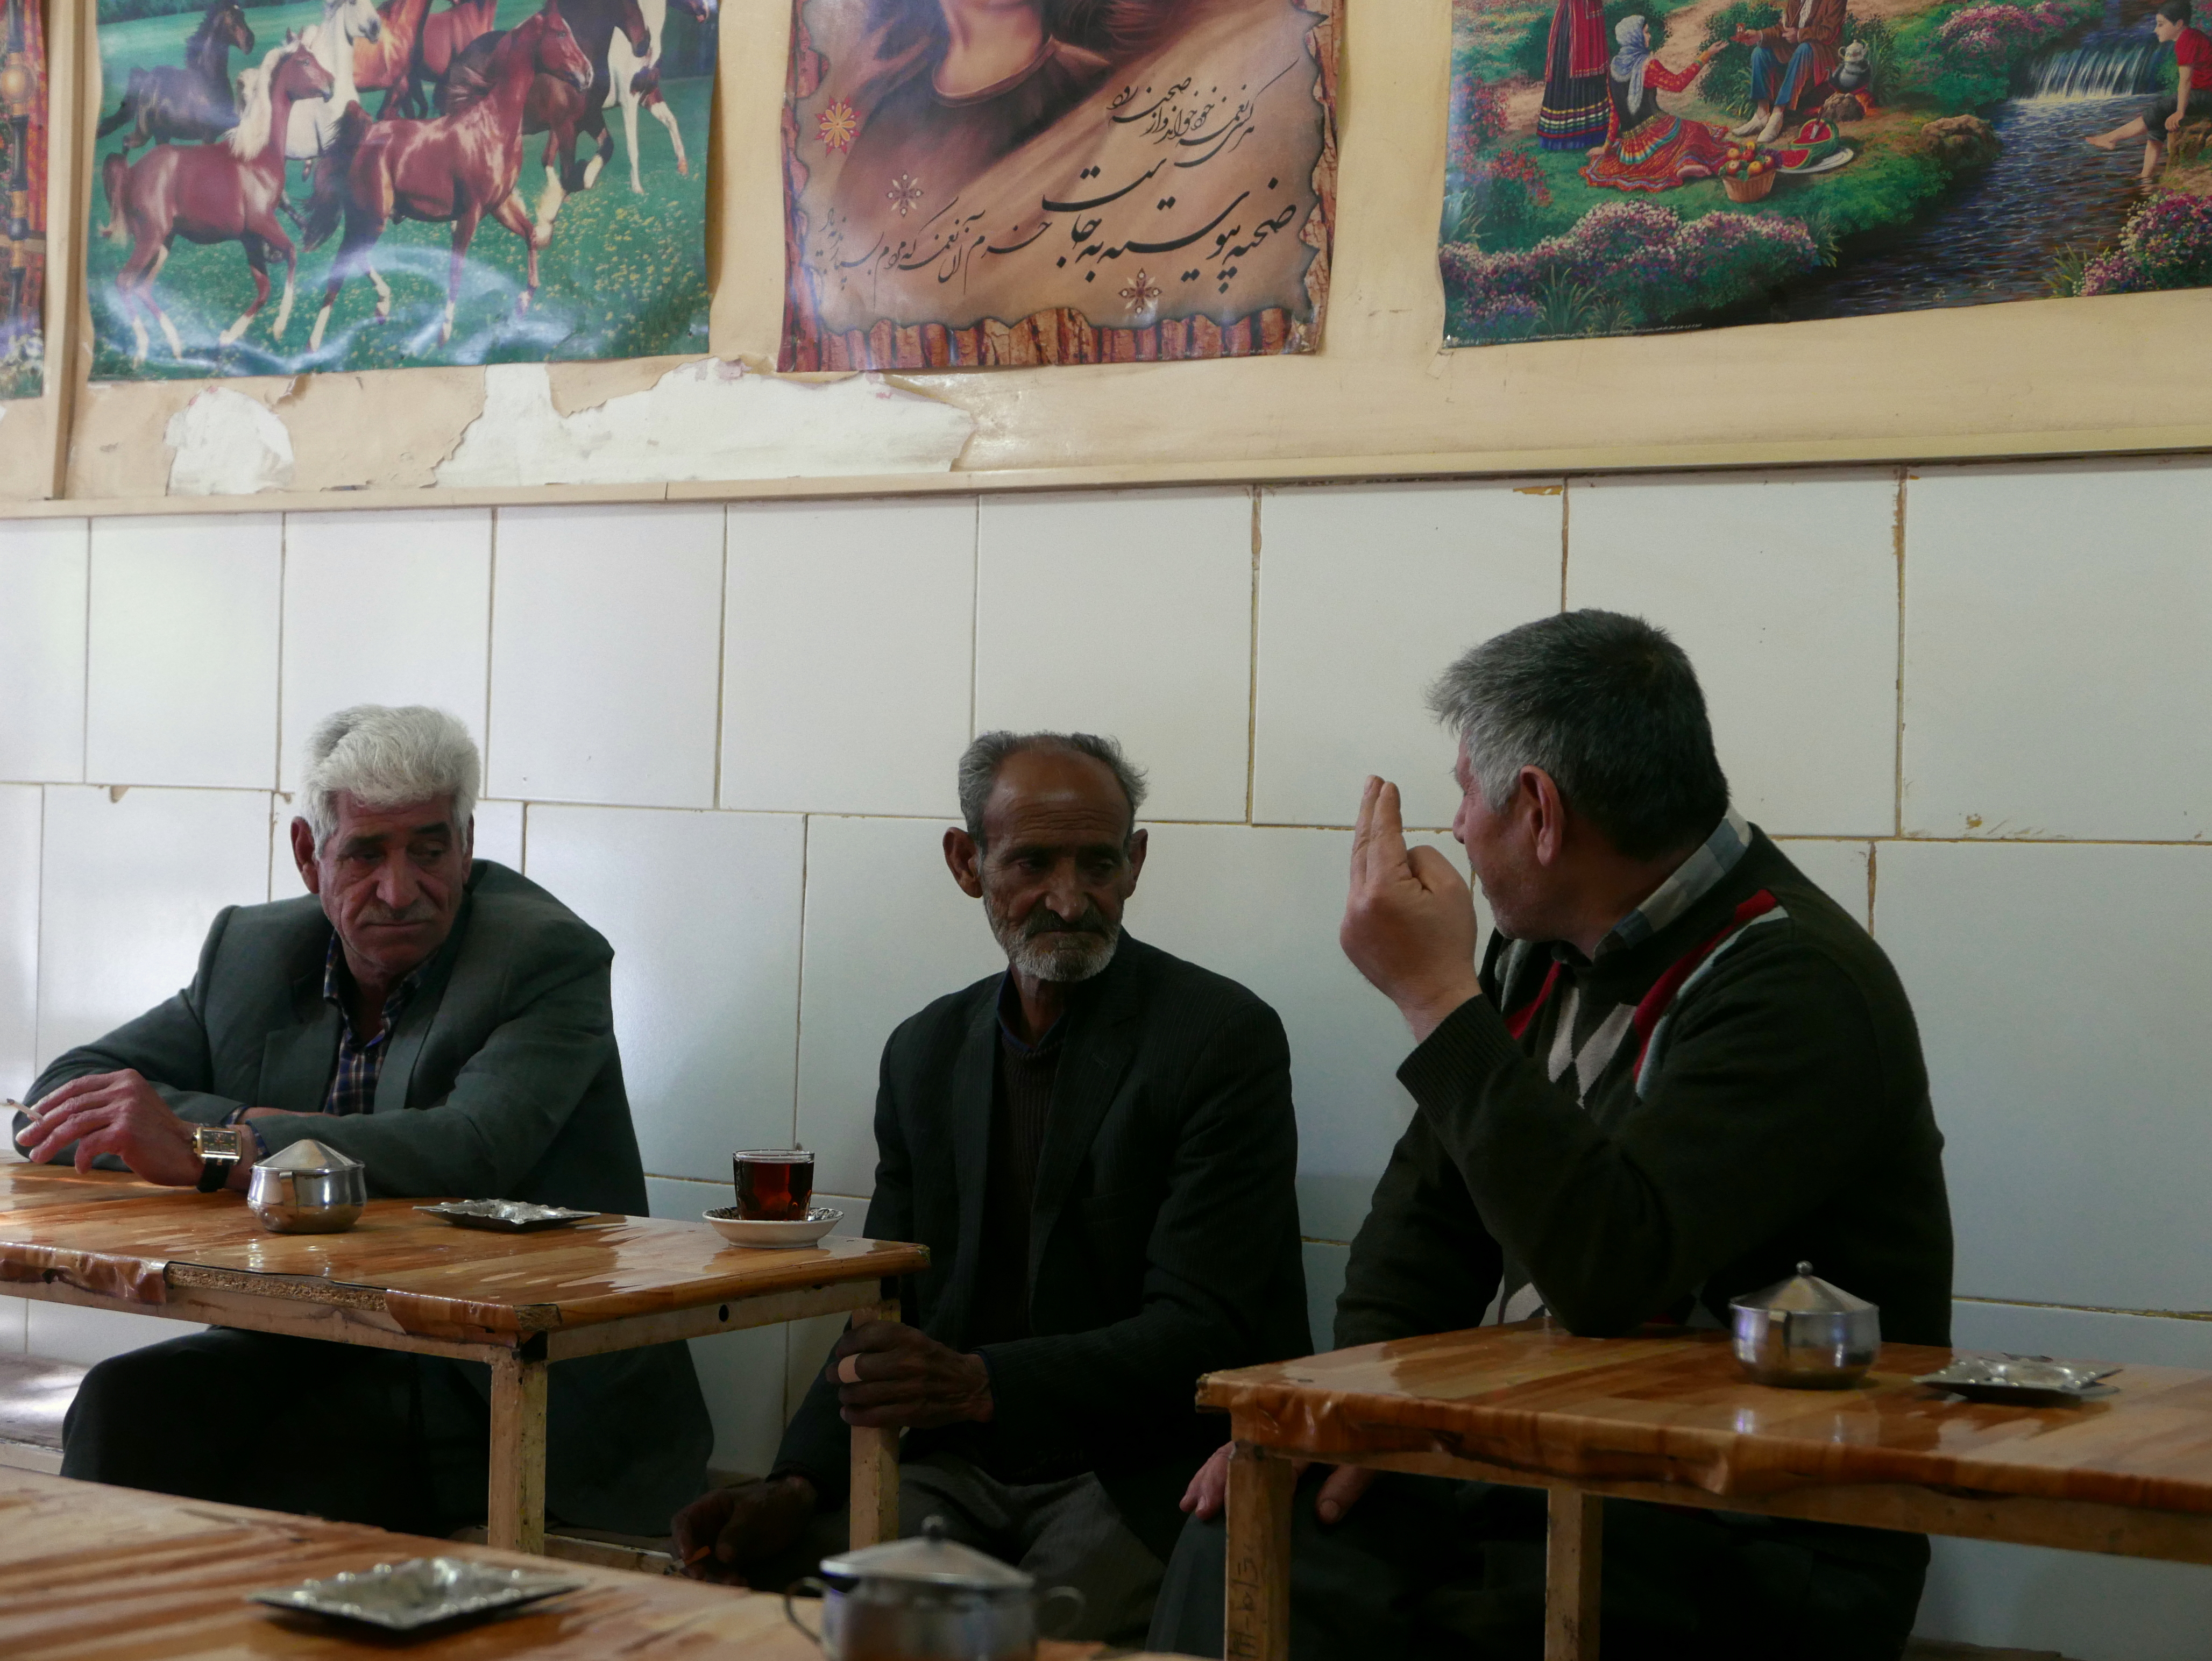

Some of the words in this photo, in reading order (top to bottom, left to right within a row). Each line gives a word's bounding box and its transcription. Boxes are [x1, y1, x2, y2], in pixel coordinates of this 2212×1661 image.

[1105, 84, 1139, 110] رود
[1108, 76, 1192, 127] صحنه
[1153, 90, 1198, 145] خواند
[1175, 83, 1251, 148] نغمه
[1189, 86, 1217, 130] خود
[1228, 123, 1255, 153] هر
[897, 218, 960, 271] نغمه
[1096, 190, 1251, 294] پیوسته
[1222, 176, 1297, 266] صحنه
[873, 240, 907, 314] مردم
[963, 221, 1053, 295] خرم
